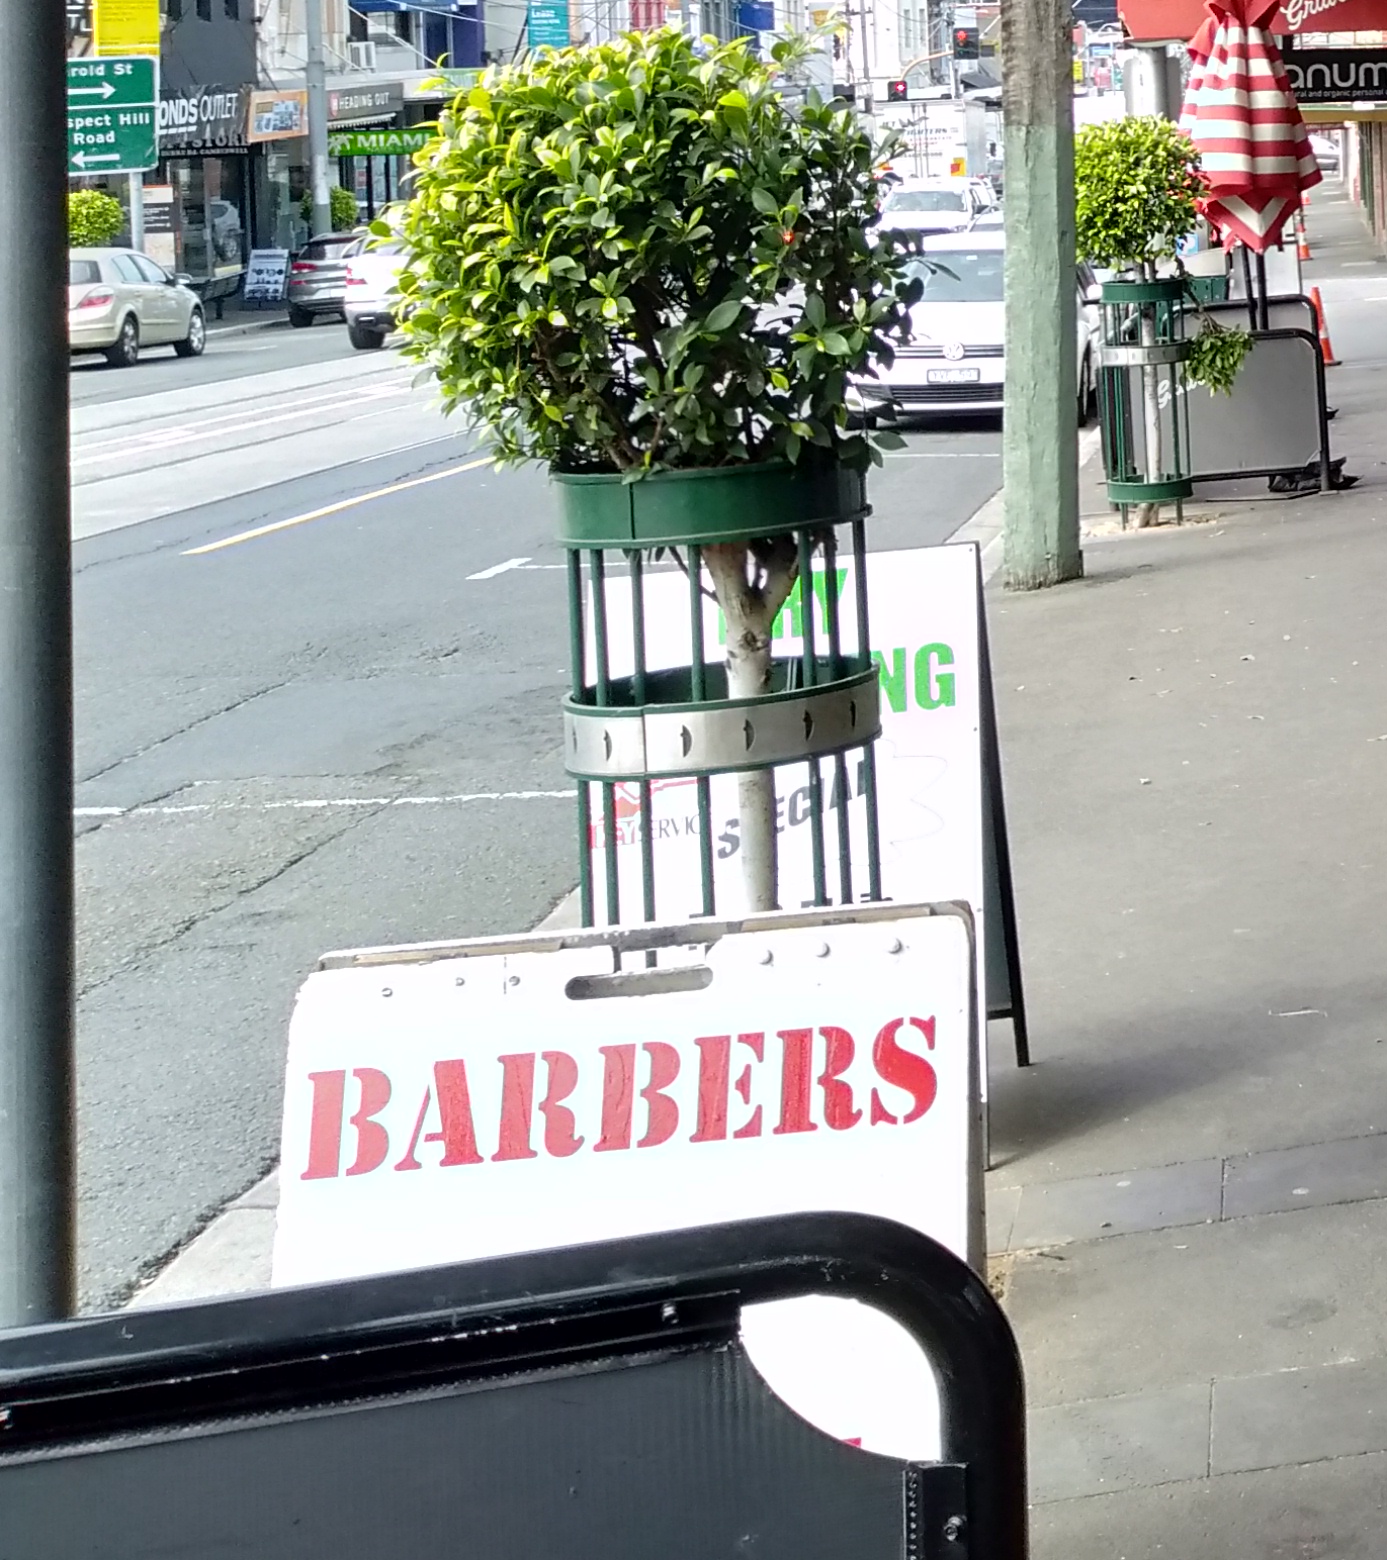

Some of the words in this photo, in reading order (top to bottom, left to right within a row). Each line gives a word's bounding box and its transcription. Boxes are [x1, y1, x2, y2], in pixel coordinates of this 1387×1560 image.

[68, 62, 105, 77] rold
[113, 62, 134, 76] St
[160, 98, 198, 128] ONDS
[200, 93, 239, 122] OUTLET
[339, 94, 373, 111] HEADING
[374, 92, 390, 105] OUT
[67, 113, 112, 130] spect
[119, 112, 150, 126] Hill
[73, 130, 116, 145] Road
[300, 1015, 938, 1181] BARBERS
